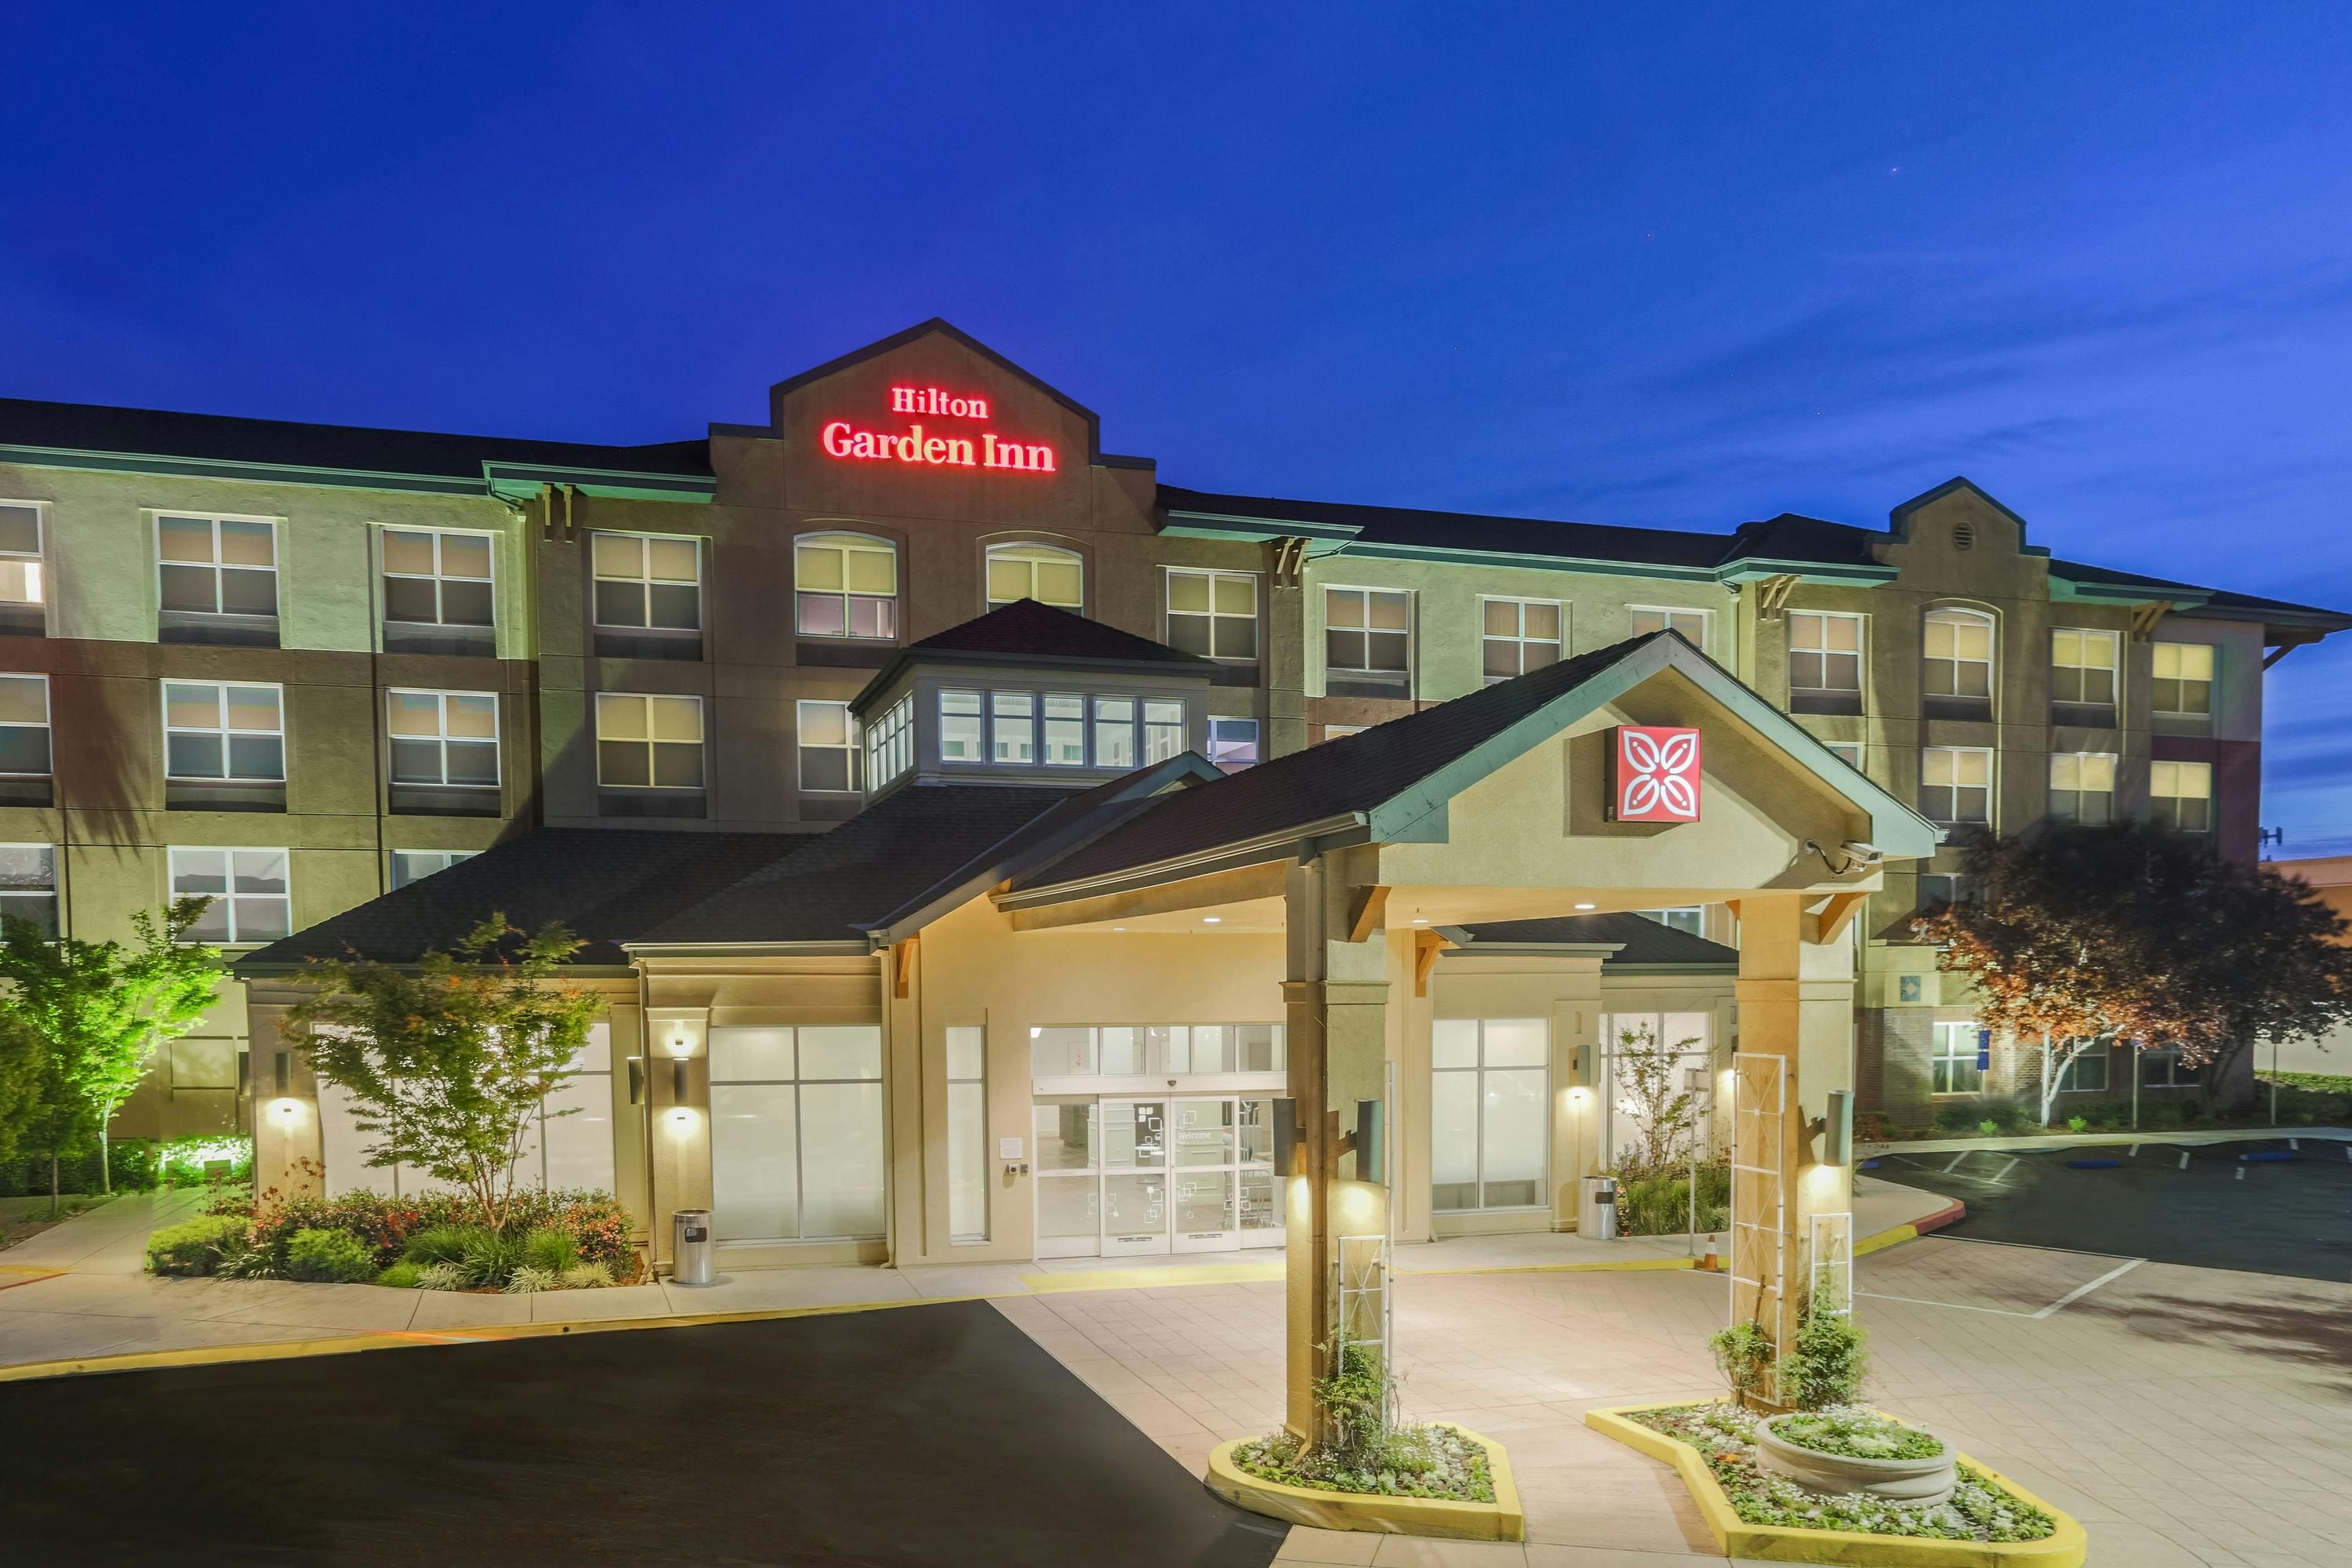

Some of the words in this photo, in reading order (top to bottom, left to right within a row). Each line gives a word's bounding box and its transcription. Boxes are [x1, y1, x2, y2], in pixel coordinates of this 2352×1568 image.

[892, 388, 988, 418] Hilton
[823, 423, 975, 466] Garden
[982, 434, 1055, 471] Inn
[1178, 1131, 1211, 1140] Welcome
